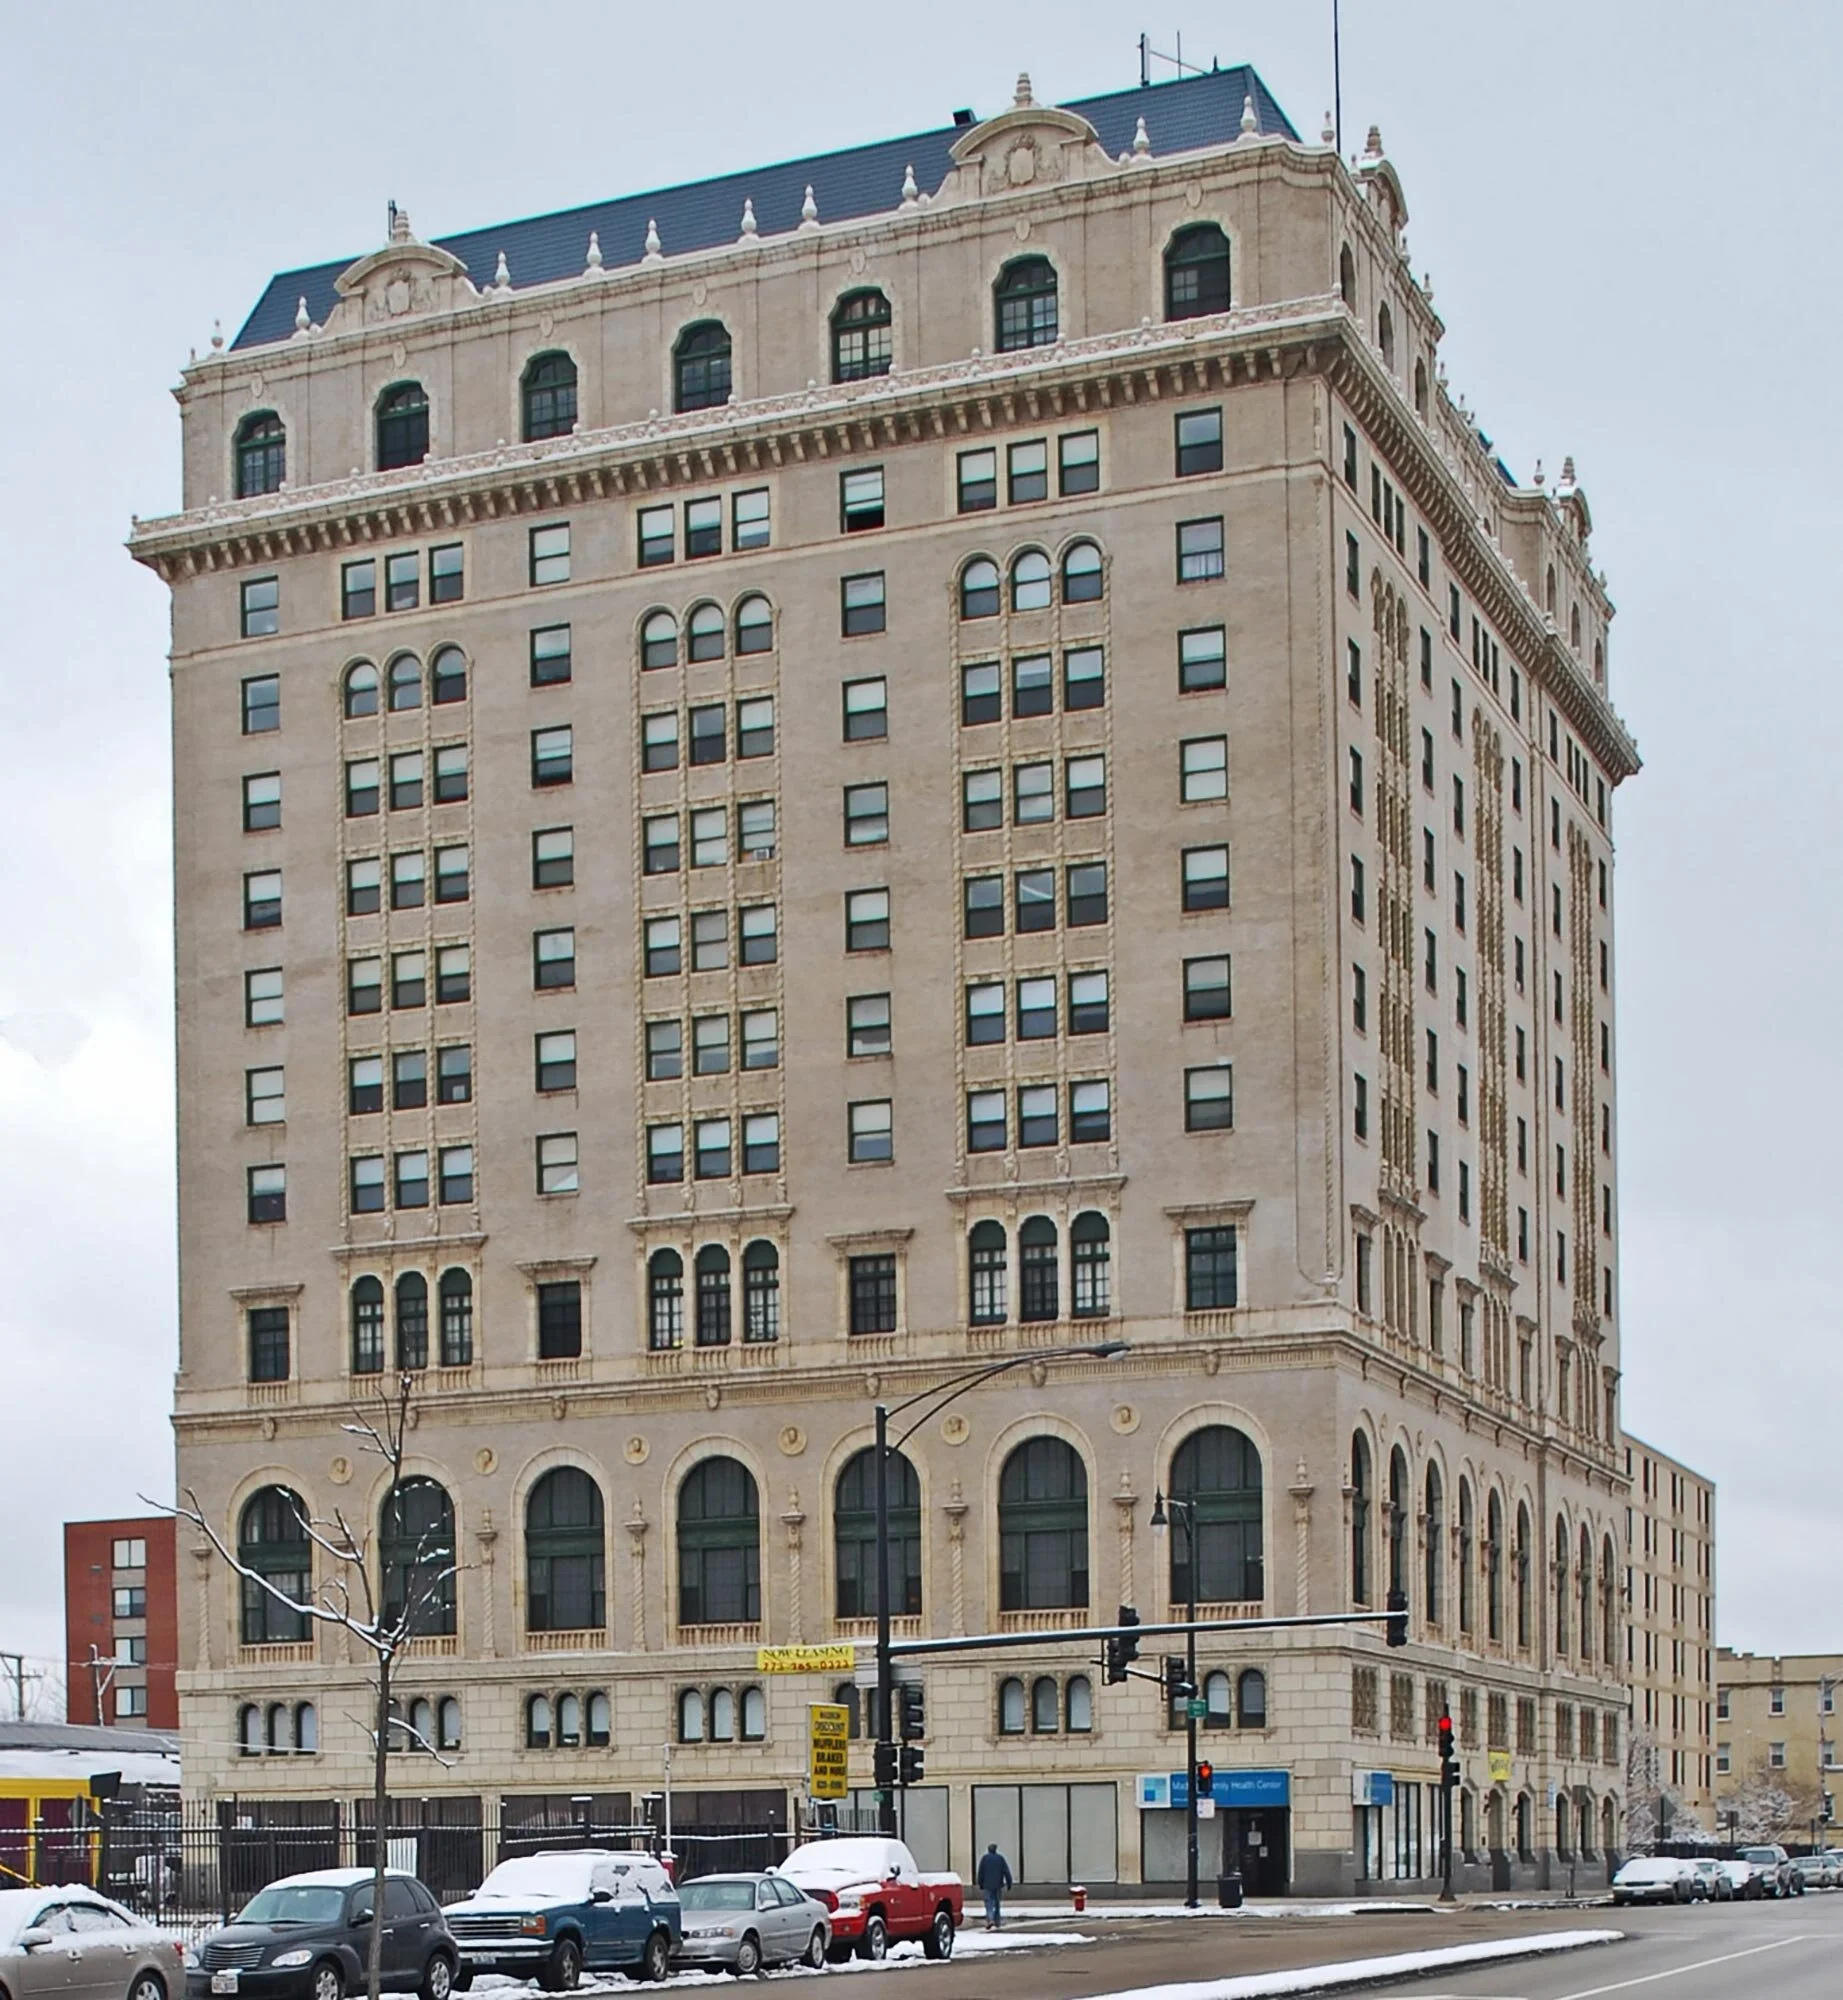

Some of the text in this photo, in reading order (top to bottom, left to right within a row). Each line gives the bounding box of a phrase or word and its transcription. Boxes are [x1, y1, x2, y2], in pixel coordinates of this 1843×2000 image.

[763, 1645, 849, 1658] NOW LEASING
[814, 1720, 845, 1732] DISCOUNT
[813, 1738, 846, 1750] MUFFLERS
[816, 1751, 844, 1763] BRAKES
[814, 1764, 846, 1776] AND MORE
[1230, 1780, 1254, 1790] Health
[1255, 1779, 1281, 1790] Center
